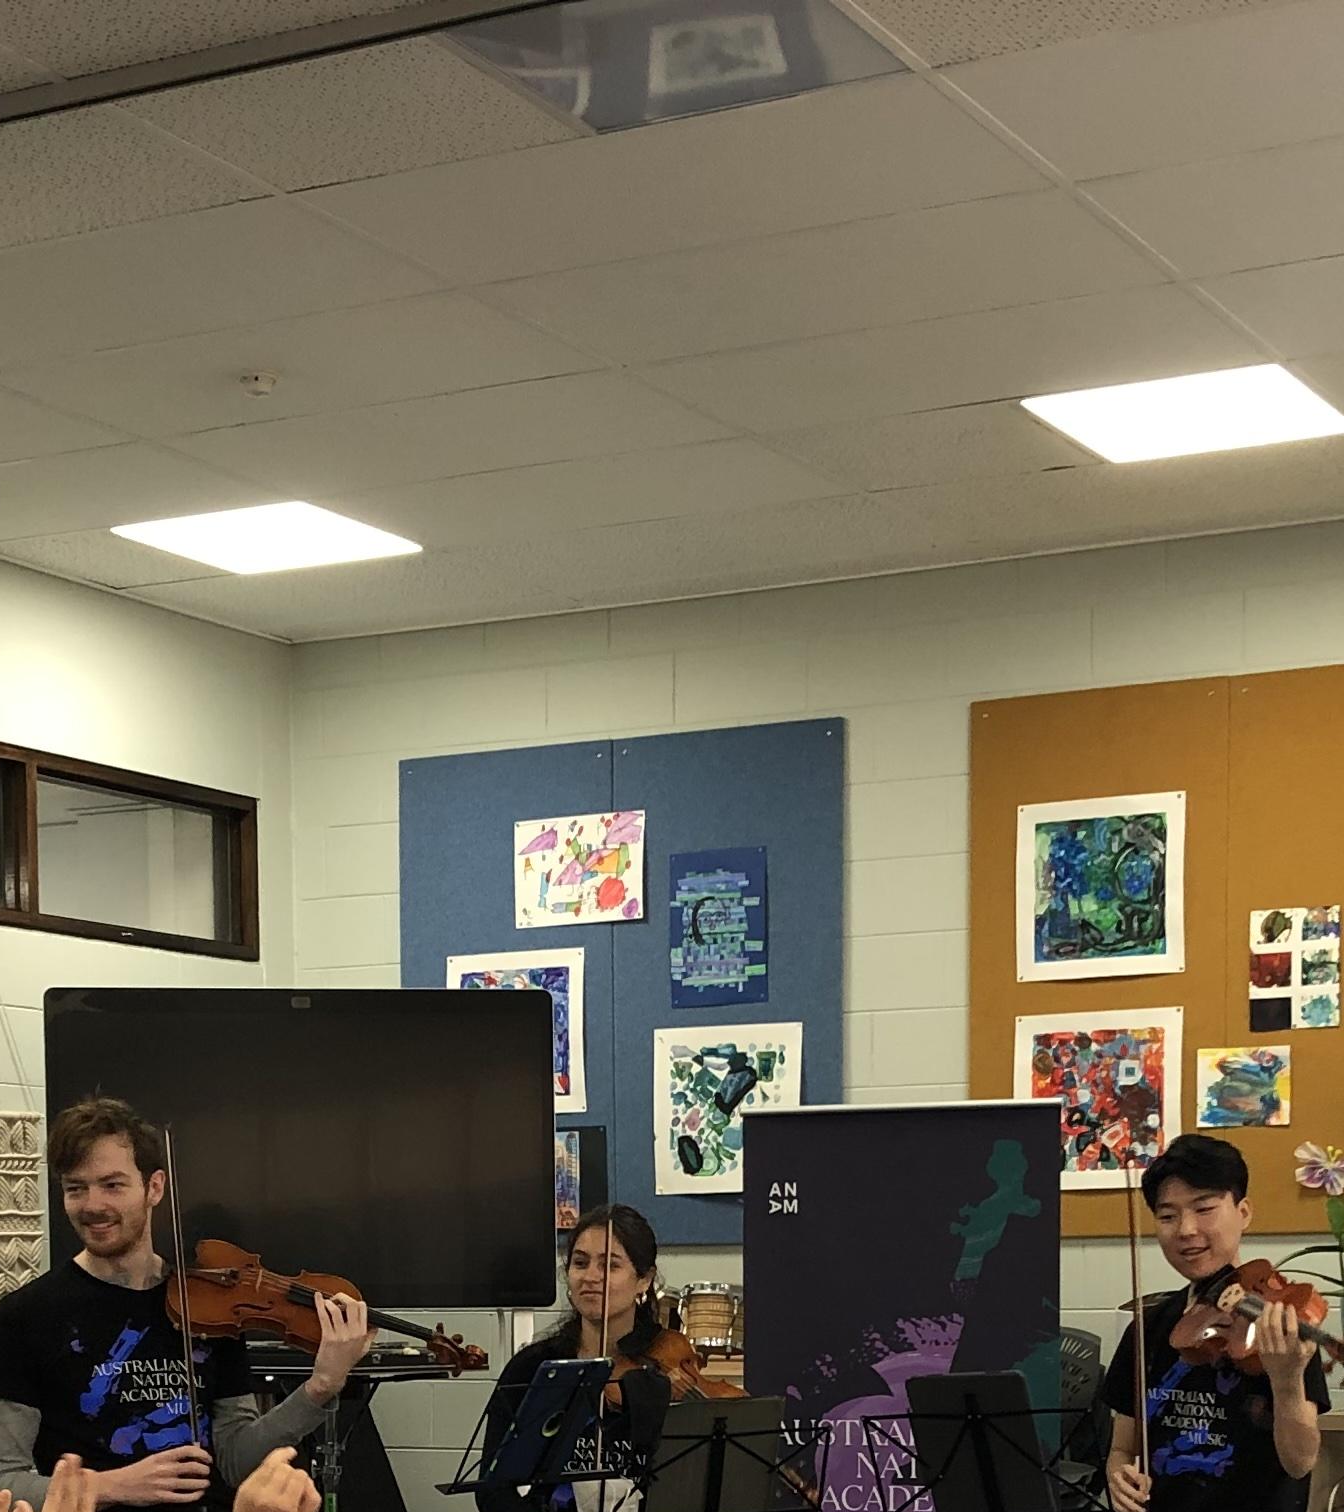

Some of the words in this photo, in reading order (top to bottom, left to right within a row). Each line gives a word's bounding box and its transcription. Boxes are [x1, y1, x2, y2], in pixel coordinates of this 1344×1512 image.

[769, 1182, 797, 1197] AN
[91, 1358, 189, 1377] AUSTRALIAN
[119, 1387, 184, 1403] ACADEM
[166, 1402, 203, 1416] MUC
[779, 1418, 916, 1446] AUSTRA
[821, 1484, 934, 1512] ACADE
